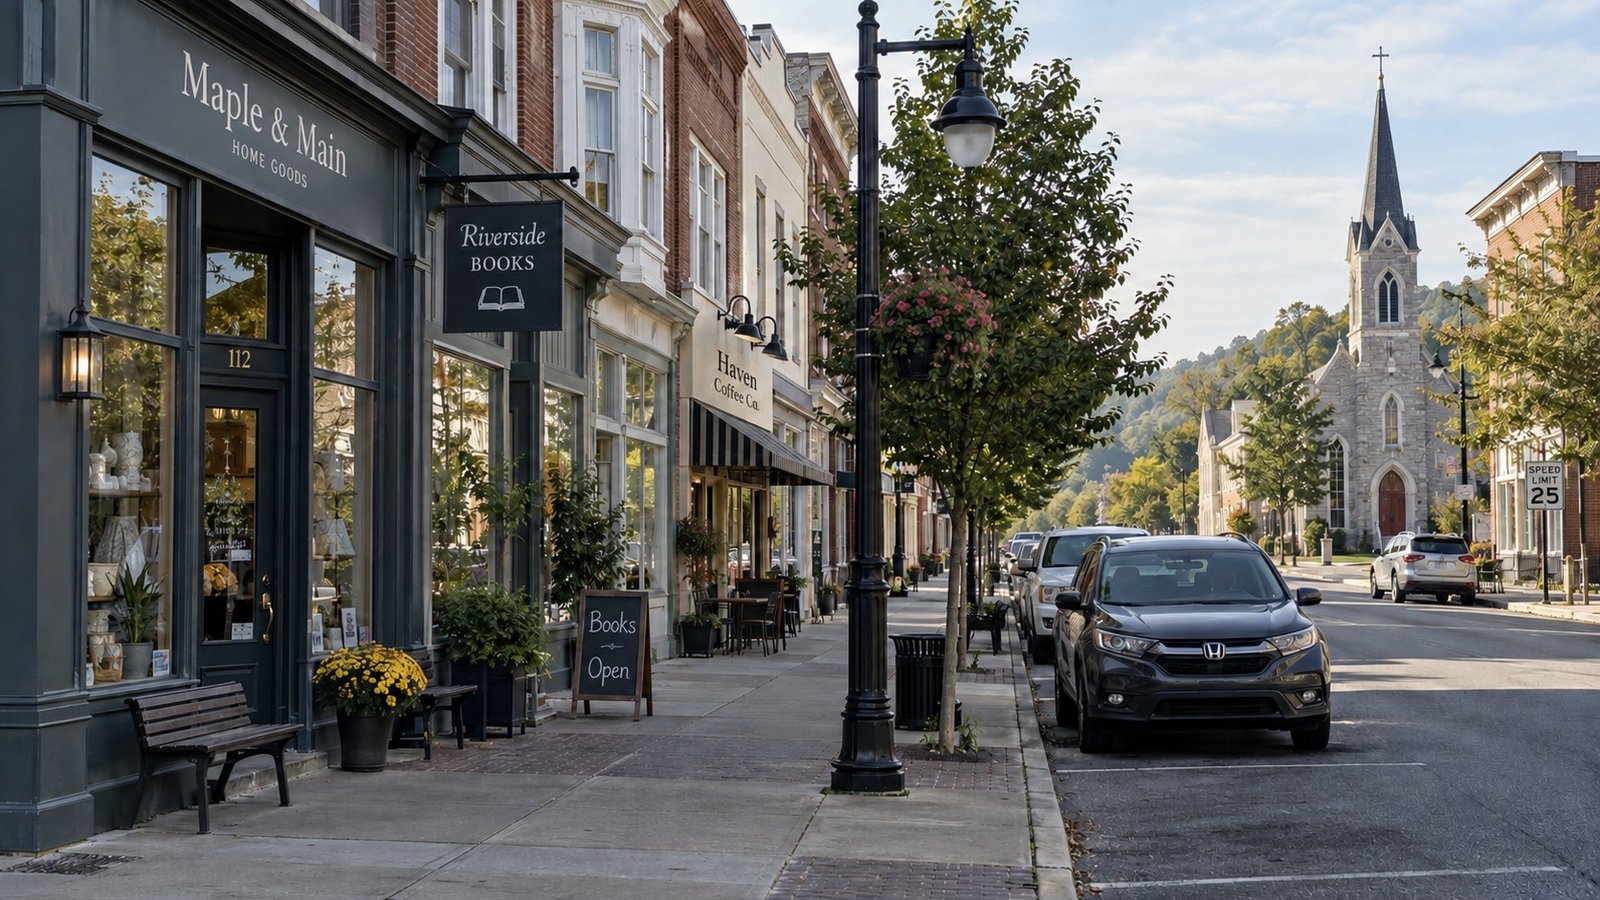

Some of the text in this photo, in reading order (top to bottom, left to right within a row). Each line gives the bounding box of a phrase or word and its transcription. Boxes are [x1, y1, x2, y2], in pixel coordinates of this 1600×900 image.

[181, 50, 347, 178] Maple & Main
[232, 139, 308, 188] HOME GOODS
[460, 222, 546, 247] Riverside
[471, 255, 534, 272] BOOKS
[228, 349, 251, 368] 112
[717, 350, 758, 390] Haven
[714, 377, 744, 404] Coffee
[1528, 465, 1561, 474] SPEED
[1532, 476, 1558, 485] LIMIT
[1531, 487, 1560, 504] 25
[588, 610, 637, 634] Books
[588, 656, 630, 687] Open
